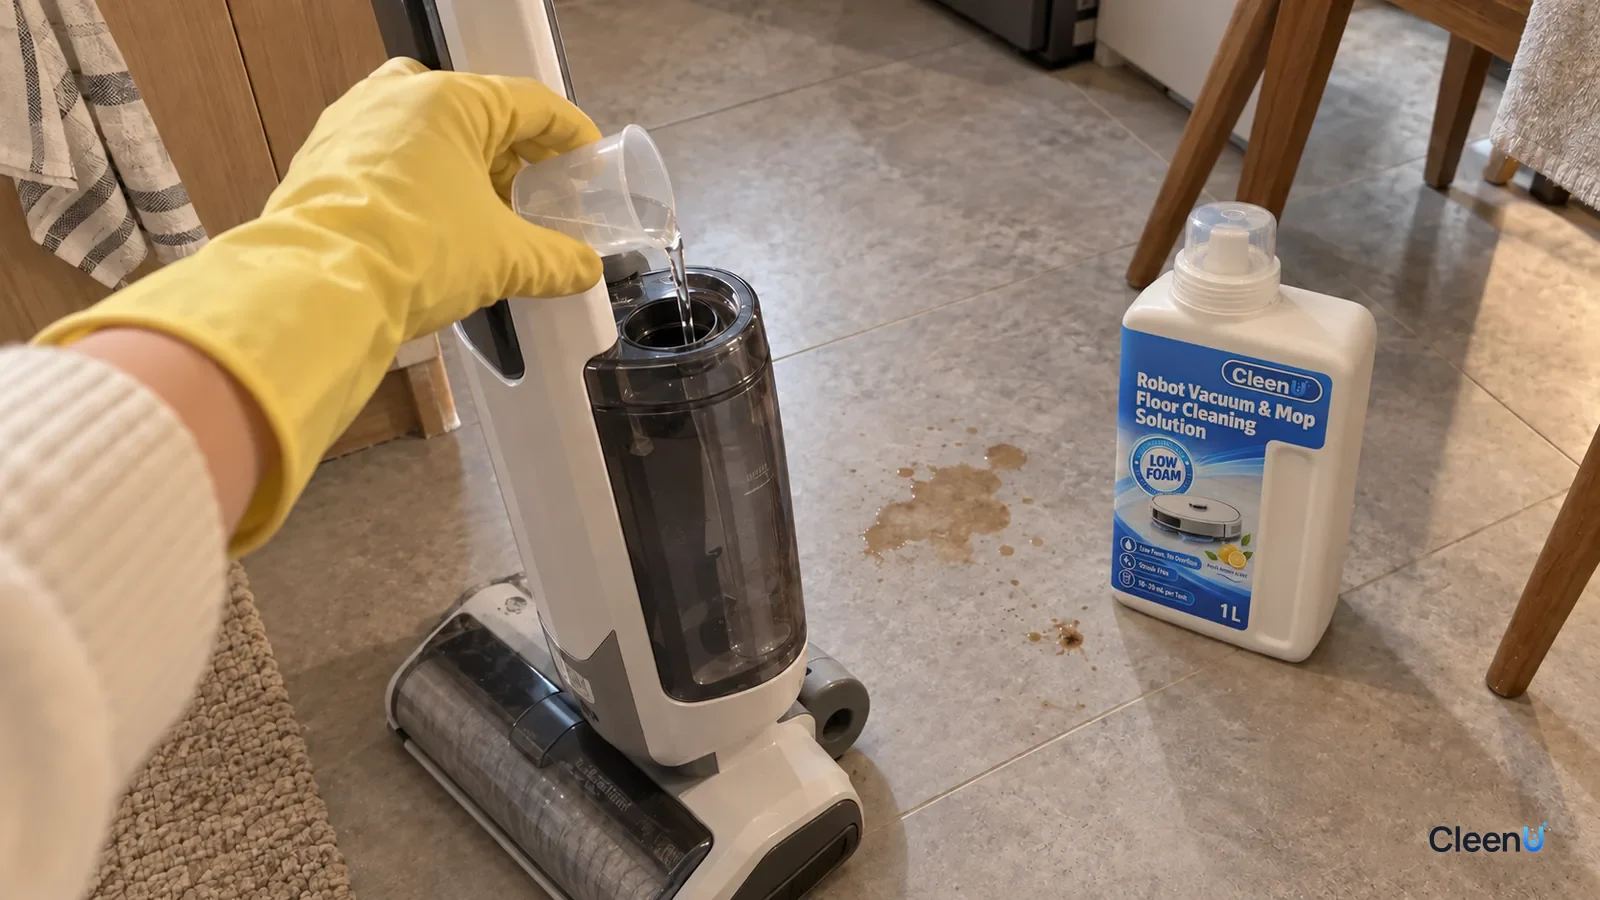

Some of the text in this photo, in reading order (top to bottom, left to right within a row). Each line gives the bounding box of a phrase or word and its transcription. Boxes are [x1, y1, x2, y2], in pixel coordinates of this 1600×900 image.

[1231, 367, 1308, 397] CleenU
[1136, 390, 1257, 436] Floor Cleaning
[1137, 372, 1315, 430] Robot Vacuum & Mop
[1135, 409, 1207, 440] Solution
[1146, 467, 1182, 482] FOAM
[1150, 454, 1178, 469] LOW
